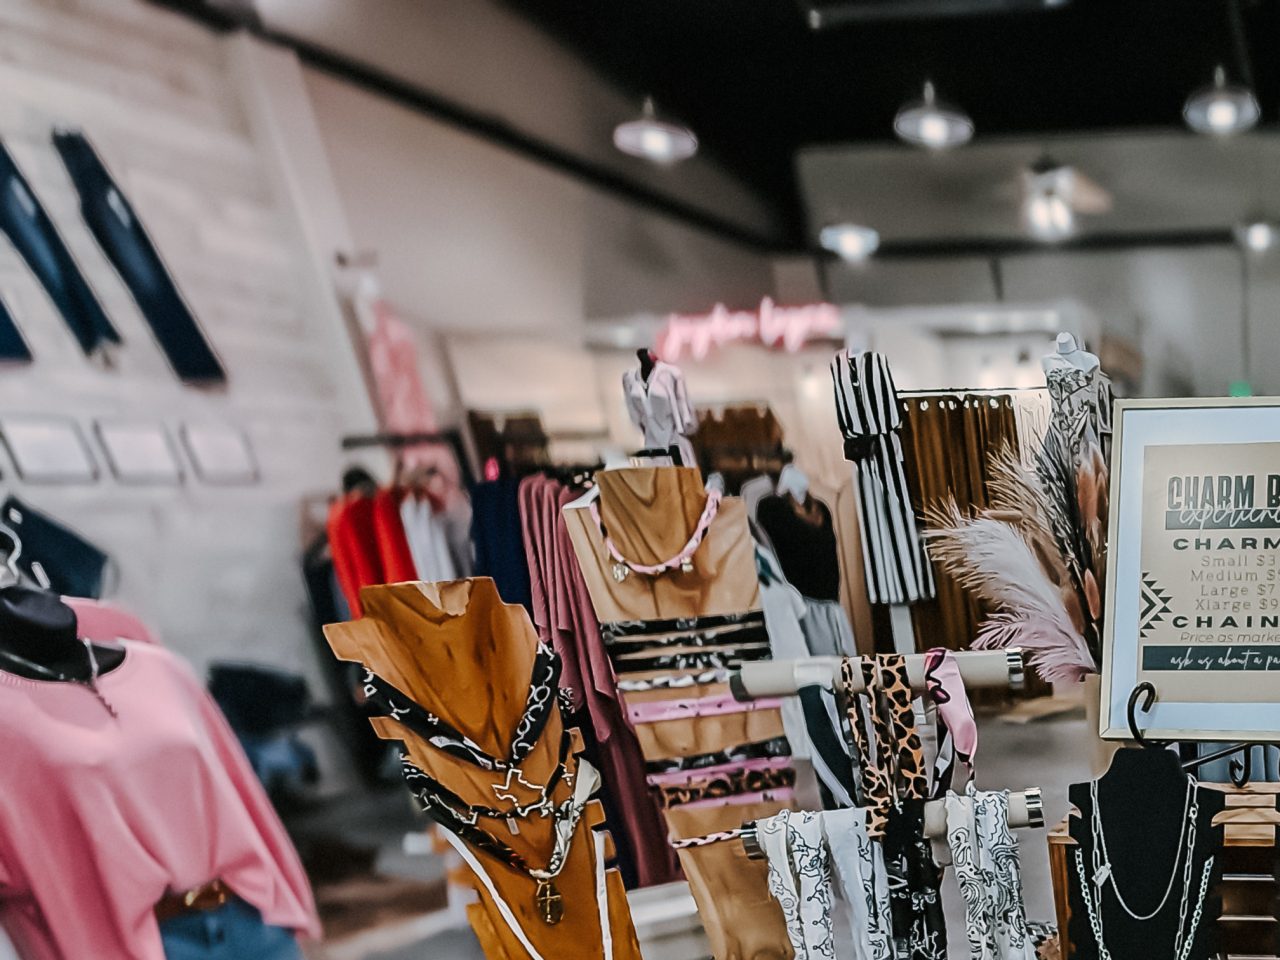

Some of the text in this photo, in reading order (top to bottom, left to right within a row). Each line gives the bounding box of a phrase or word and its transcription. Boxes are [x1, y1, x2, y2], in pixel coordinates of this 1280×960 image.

[1167, 475, 1255, 509] CHARM
[1201, 555, 1276, 567] Small $3
[1190, 570, 1258, 581] Medium
[1201, 584, 1276, 598] Large $7
[1259, 599, 1279, 611] $9
[1180, 632, 1214, 643] Price
[1217, 634, 1233, 643] as
[1170, 647, 1193, 670] ask
[1197, 657, 1213, 669] us
[1217, 647, 1258, 669] about
